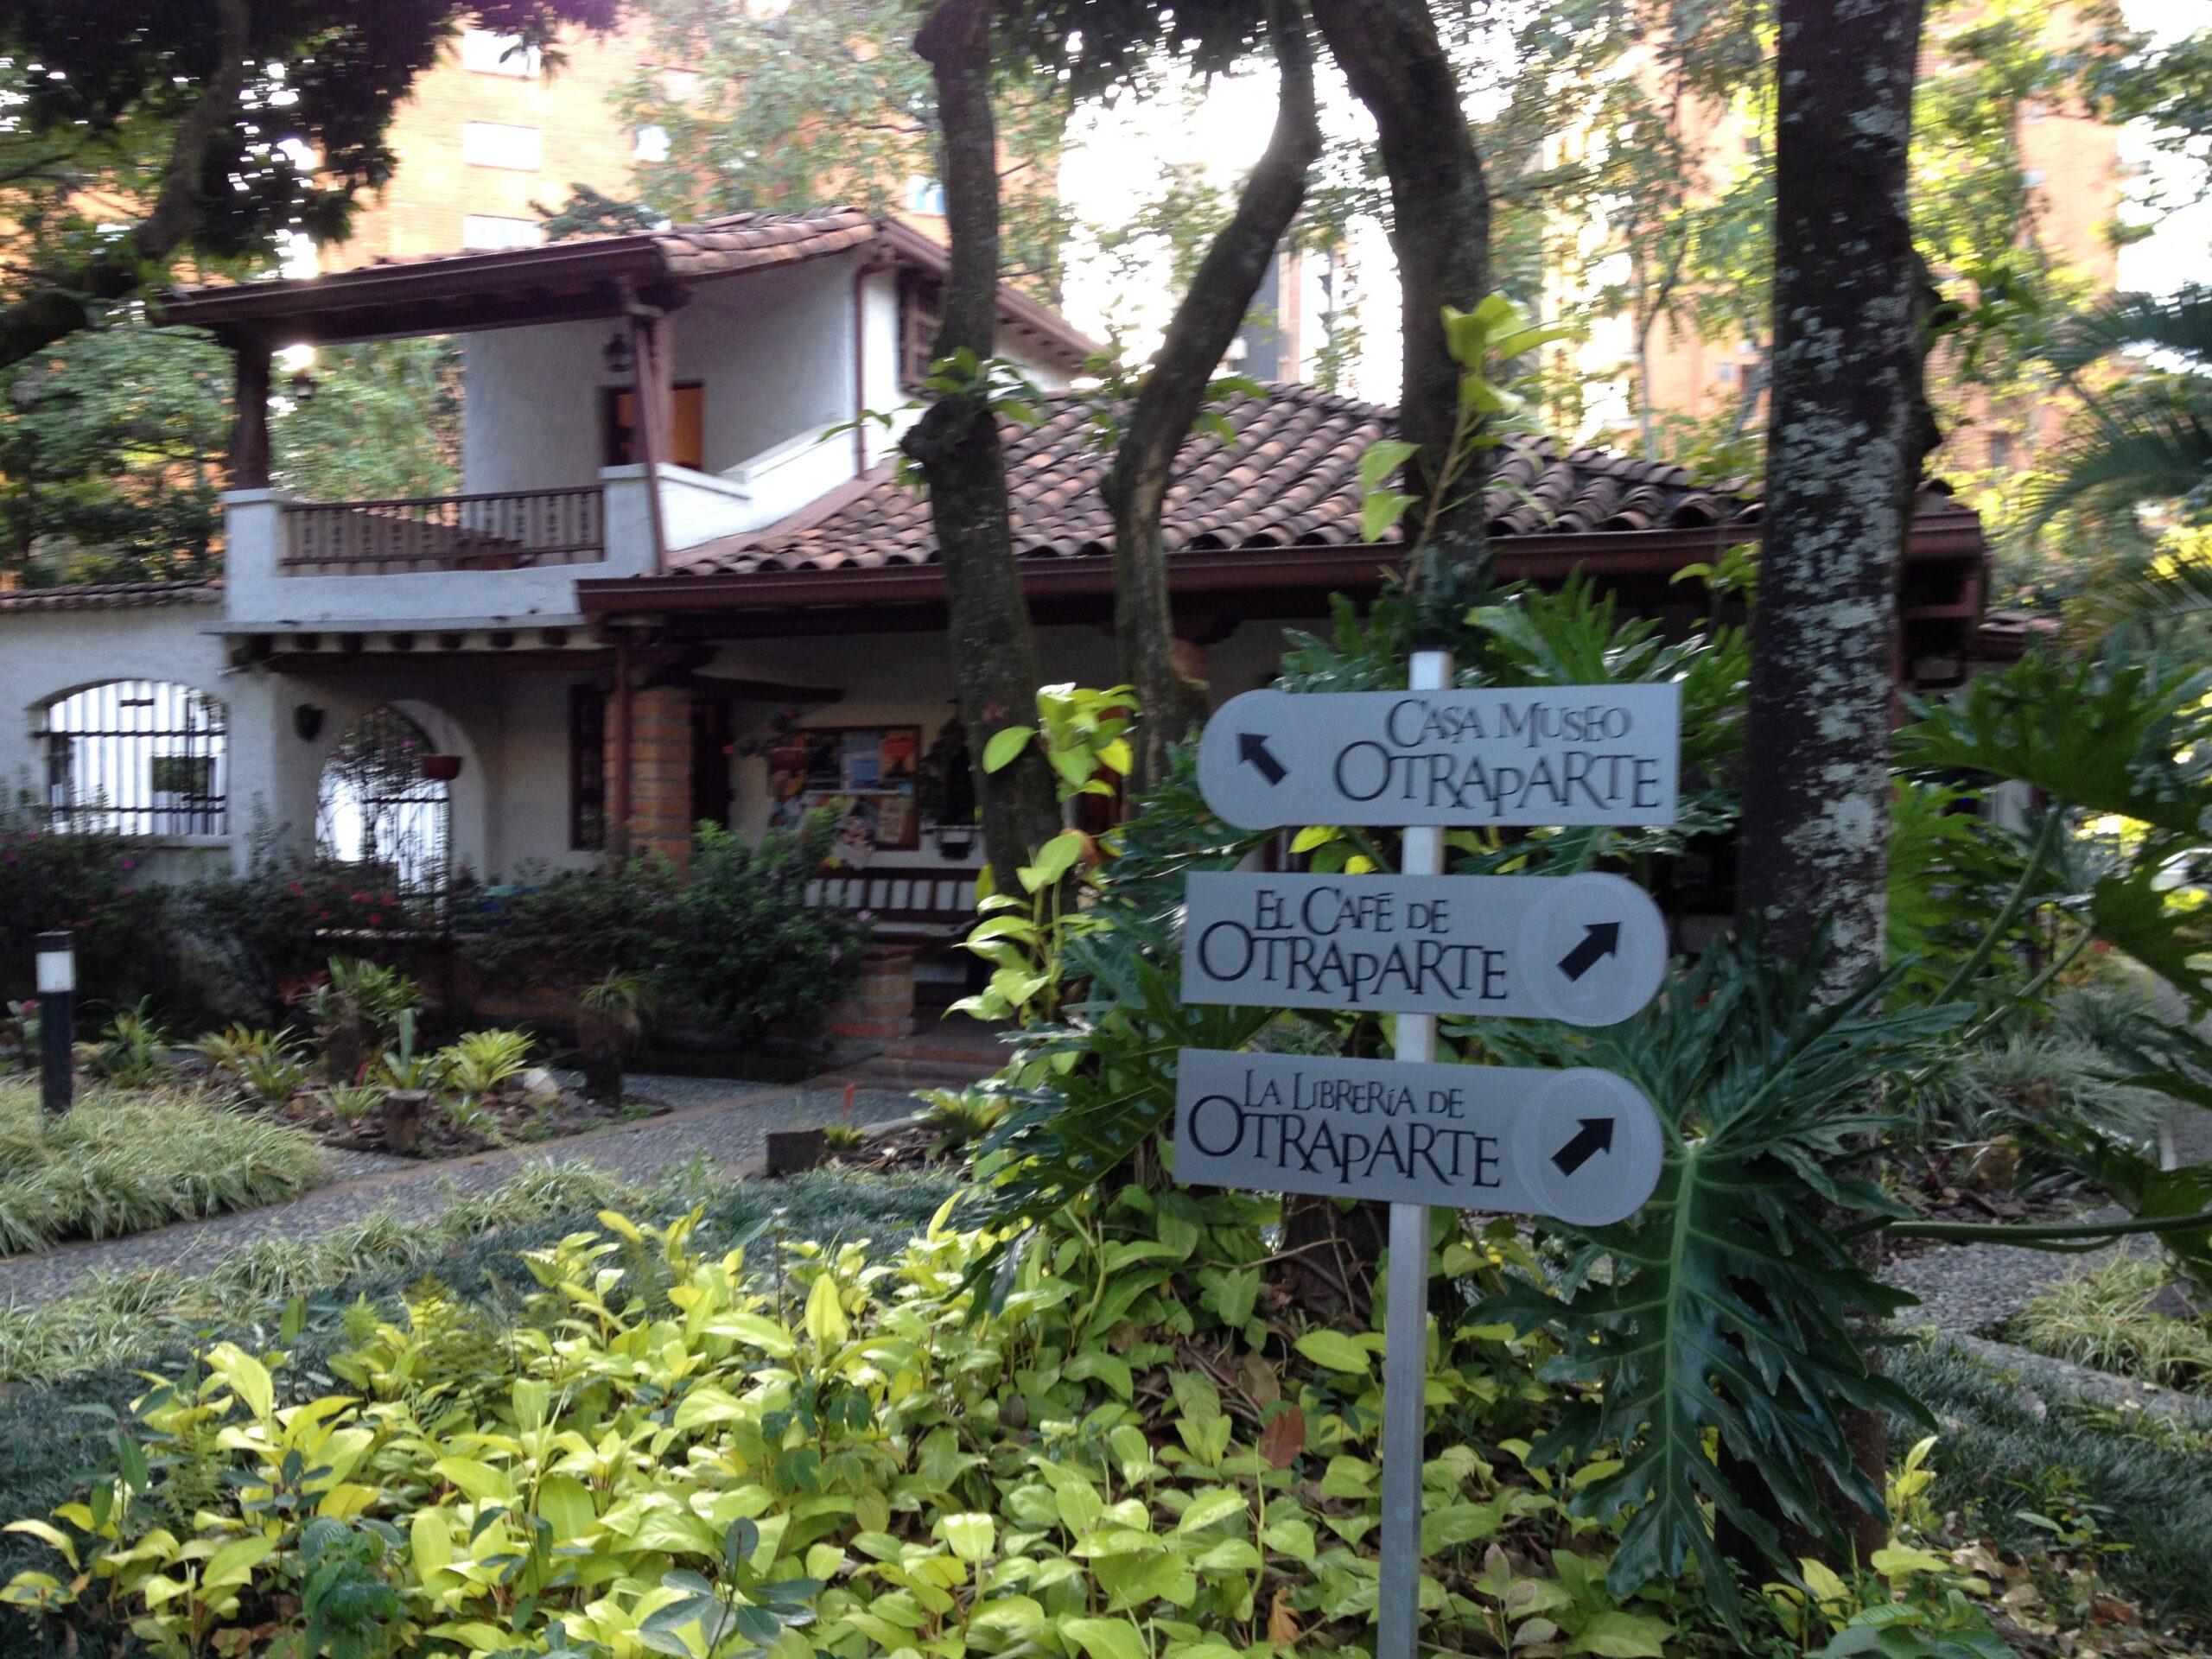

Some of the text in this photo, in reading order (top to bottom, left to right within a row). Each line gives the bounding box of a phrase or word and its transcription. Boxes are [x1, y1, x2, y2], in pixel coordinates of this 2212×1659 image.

[1386, 698, 1633, 748] CASA MUSEO
[1334, 741, 1662, 817] OTRAPARTE
[1254, 890, 1294, 931] EL
[1407, 899, 1449, 934] DE
[1197, 920, 1508, 1002] OTRAPARTE
[1244, 1069, 1281, 1108] LA
[1427, 1087, 1465, 1118] DE
[1188, 1094, 1501, 1187] OTRAPARTE
